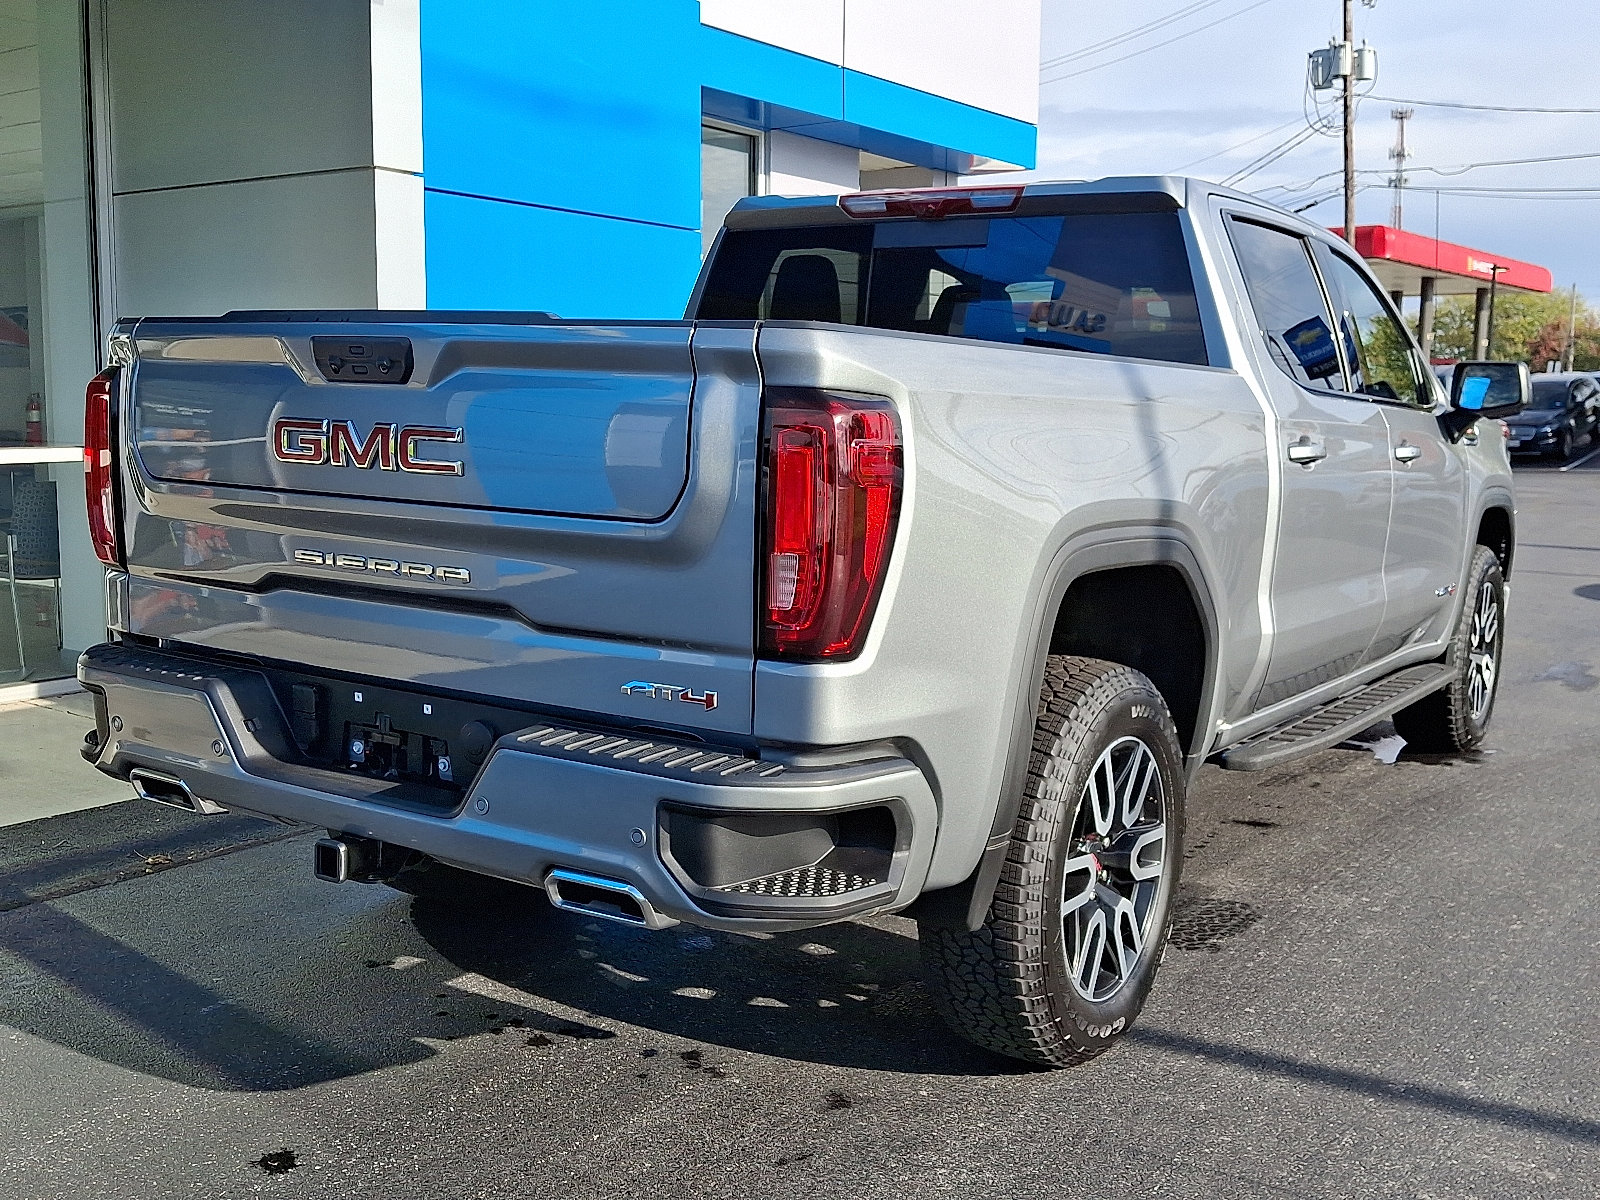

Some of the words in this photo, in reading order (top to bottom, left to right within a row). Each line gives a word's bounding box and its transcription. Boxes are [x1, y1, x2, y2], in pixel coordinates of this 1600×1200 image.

[274, 417, 464, 477] GMC
[294, 549, 471, 583] SIERRA
[620, 679, 718, 712] AT4
